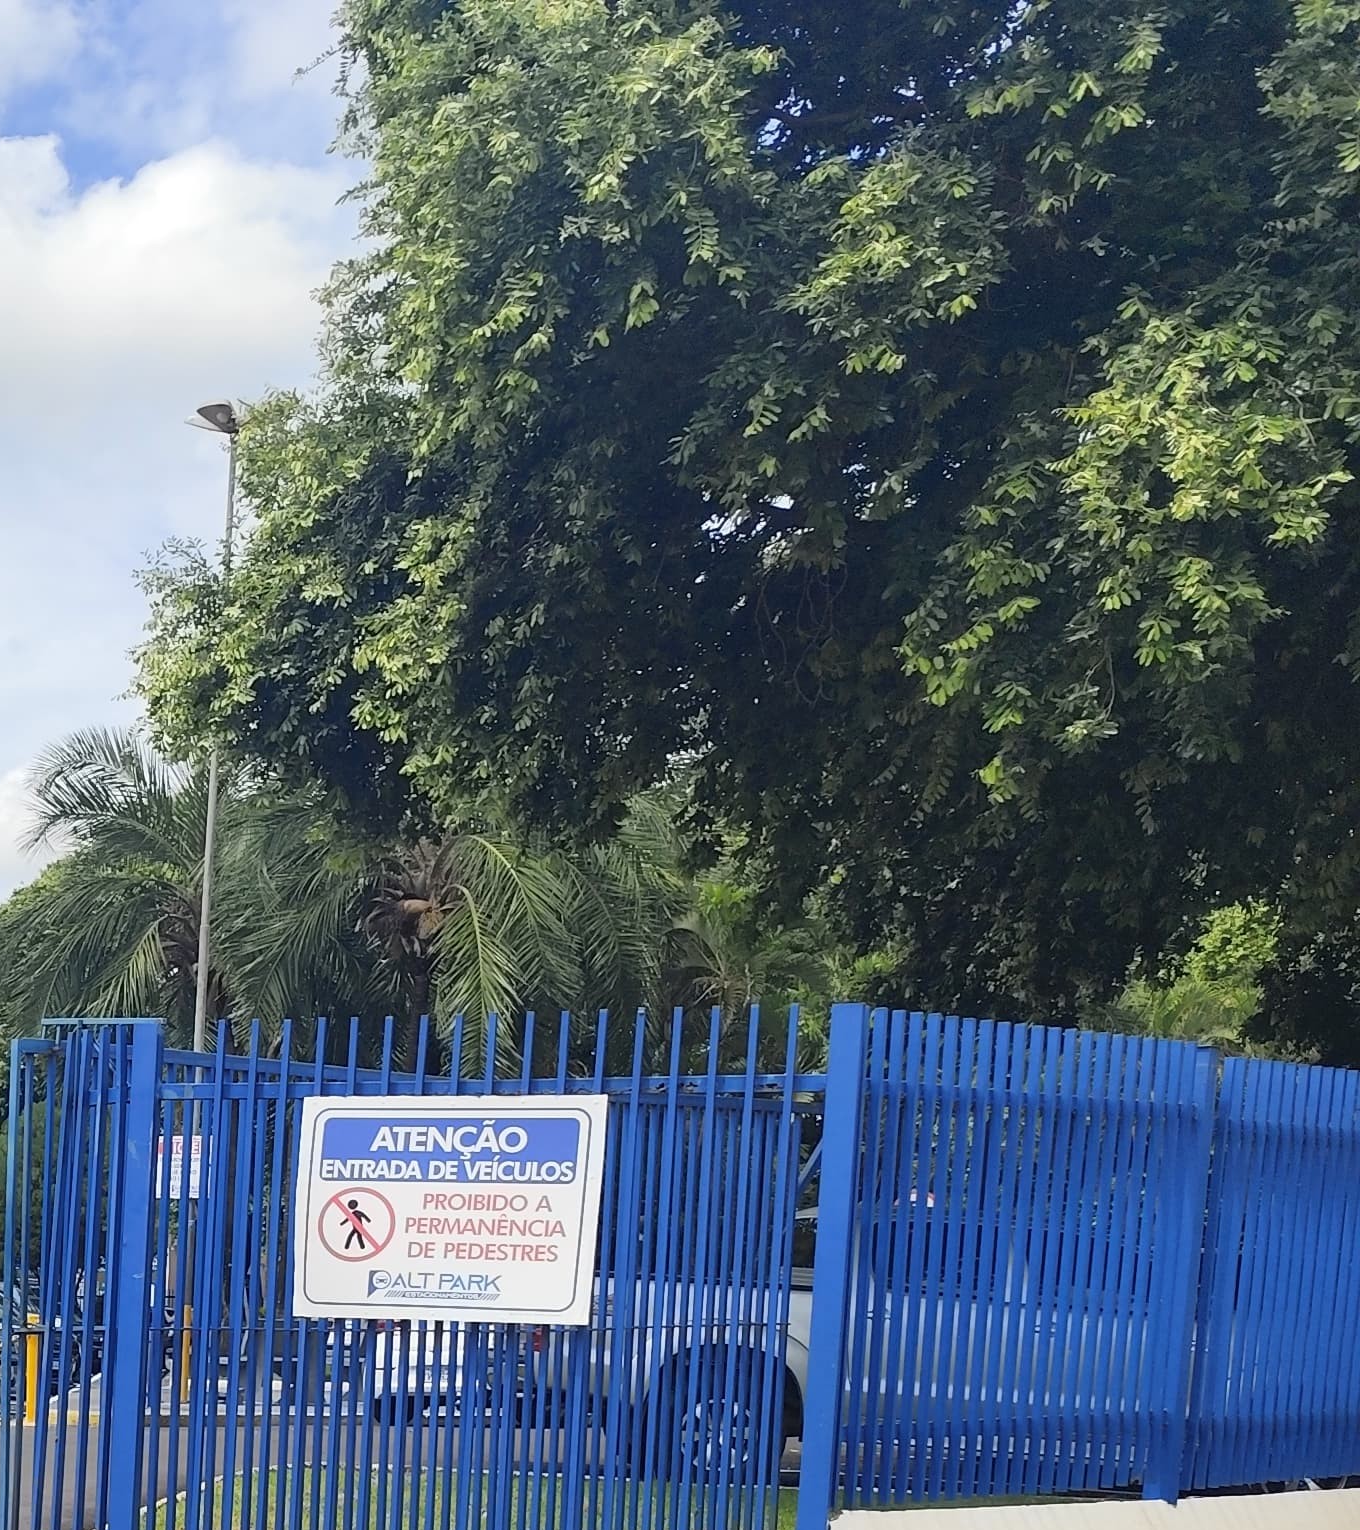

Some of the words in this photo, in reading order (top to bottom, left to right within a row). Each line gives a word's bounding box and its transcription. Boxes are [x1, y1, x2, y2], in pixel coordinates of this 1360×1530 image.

[369, 1120, 529, 1160] ATENÇÃO
[321, 1159, 422, 1180] ENTRADA
[427, 1161, 458, 1180] DE
[463, 1155, 574, 1182] VEÍCULOS
[422, 1193, 528, 1212] PROIBIDO
[535, 1195, 552, 1213] A
[404, 1214, 566, 1238] PERMANÊNCIA
[407, 1241, 436, 1259] DE
[443, 1242, 558, 1262] PEDESTRES
[439, 1273, 502, 1292] PARK
